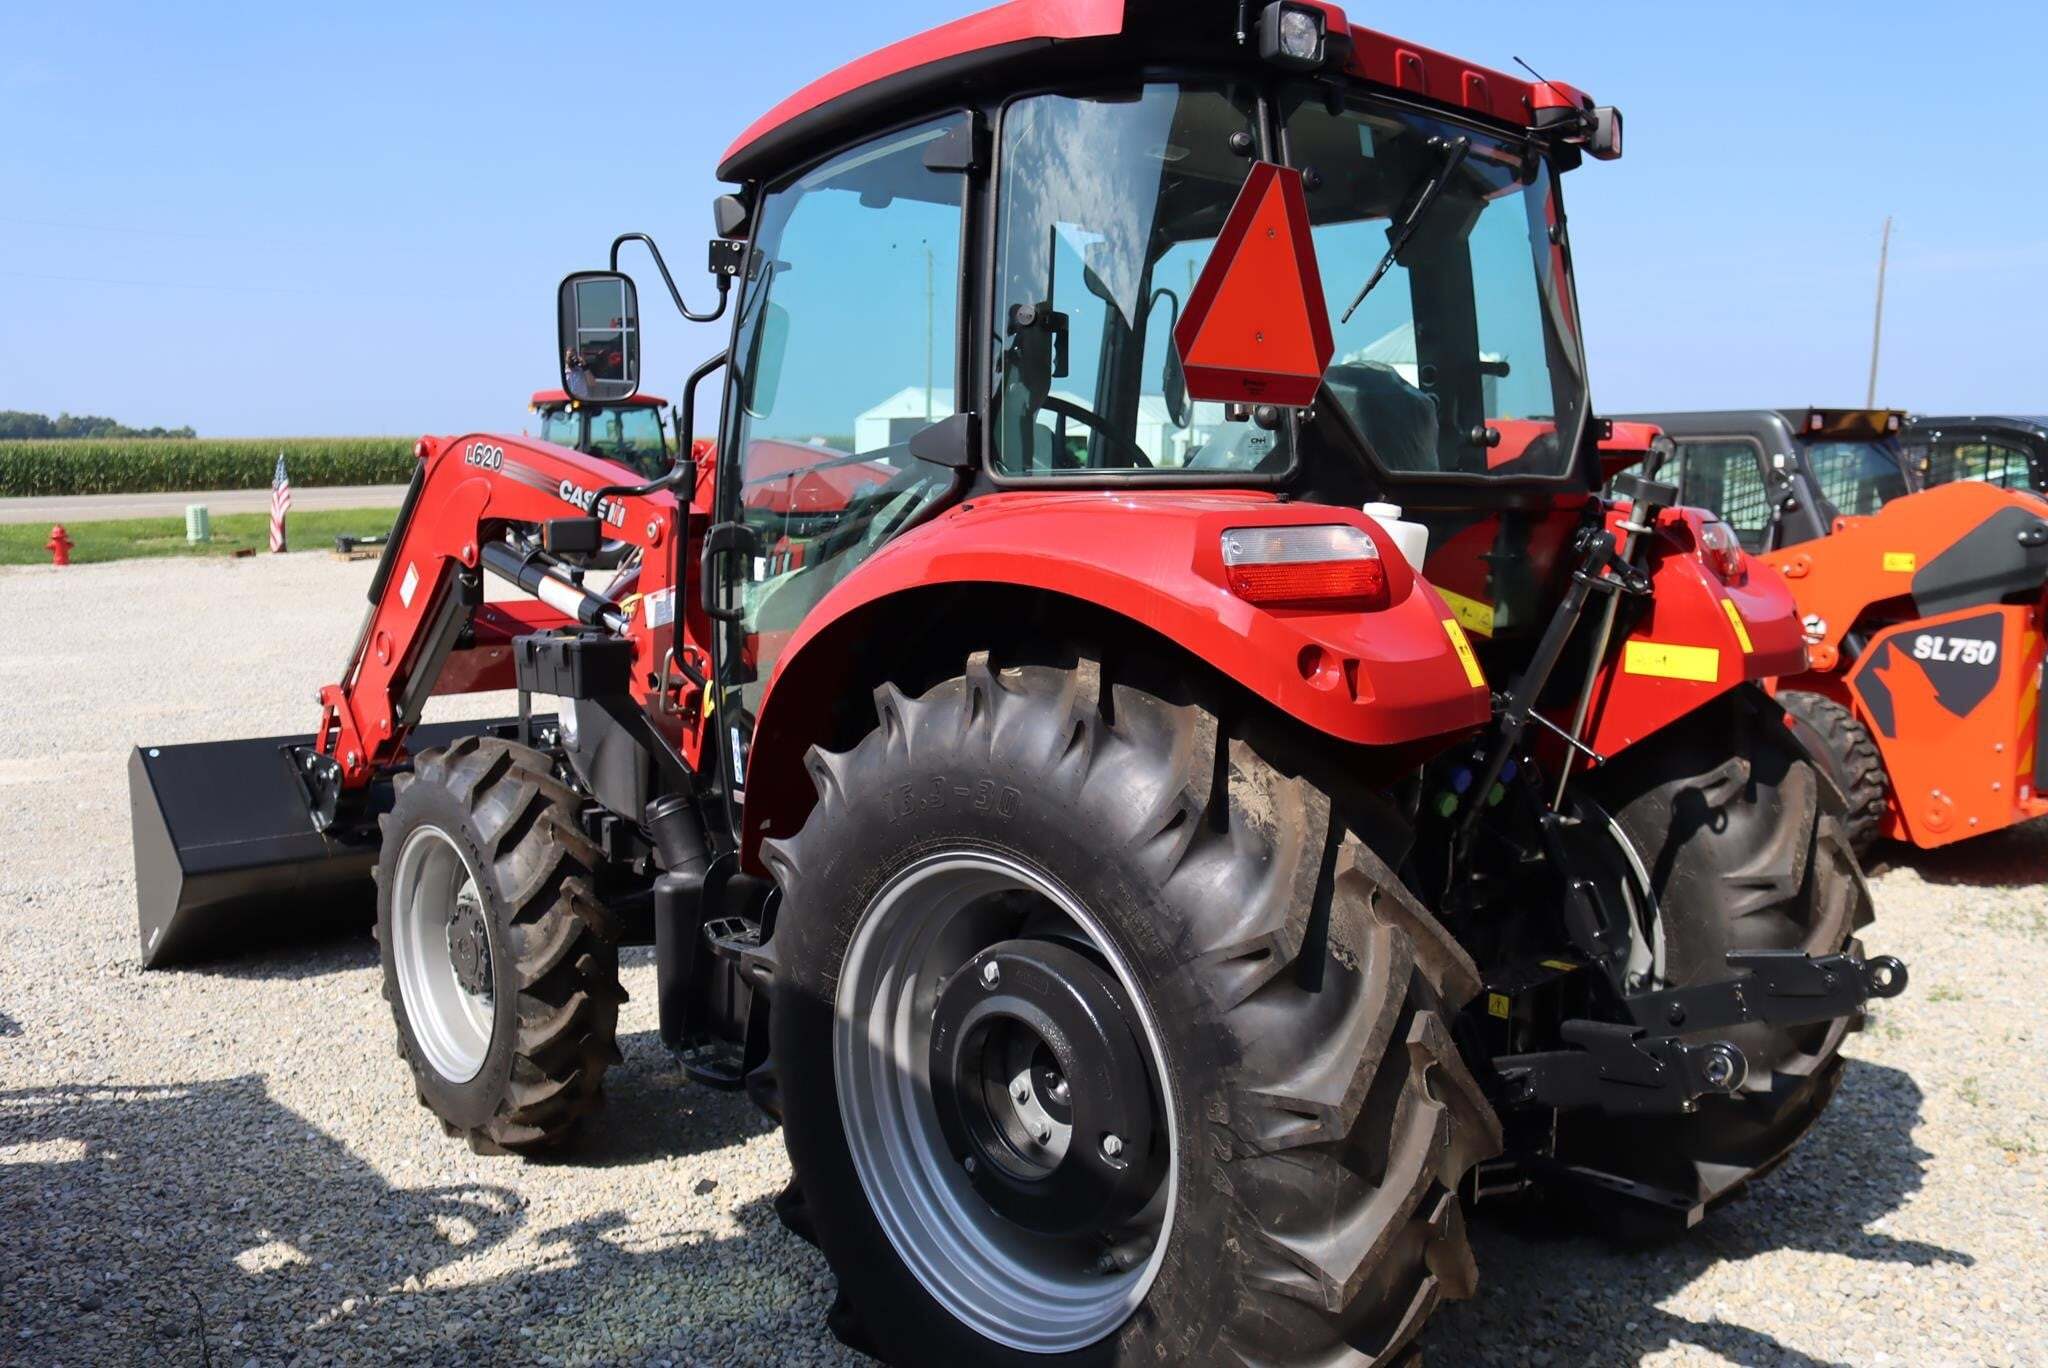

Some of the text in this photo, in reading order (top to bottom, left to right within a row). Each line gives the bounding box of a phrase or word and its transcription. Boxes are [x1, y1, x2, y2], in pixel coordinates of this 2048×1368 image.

[465, 442, 504, 472] L620
[559, 480, 609, 520] CASE
[1912, 634, 1998, 666] SL750
